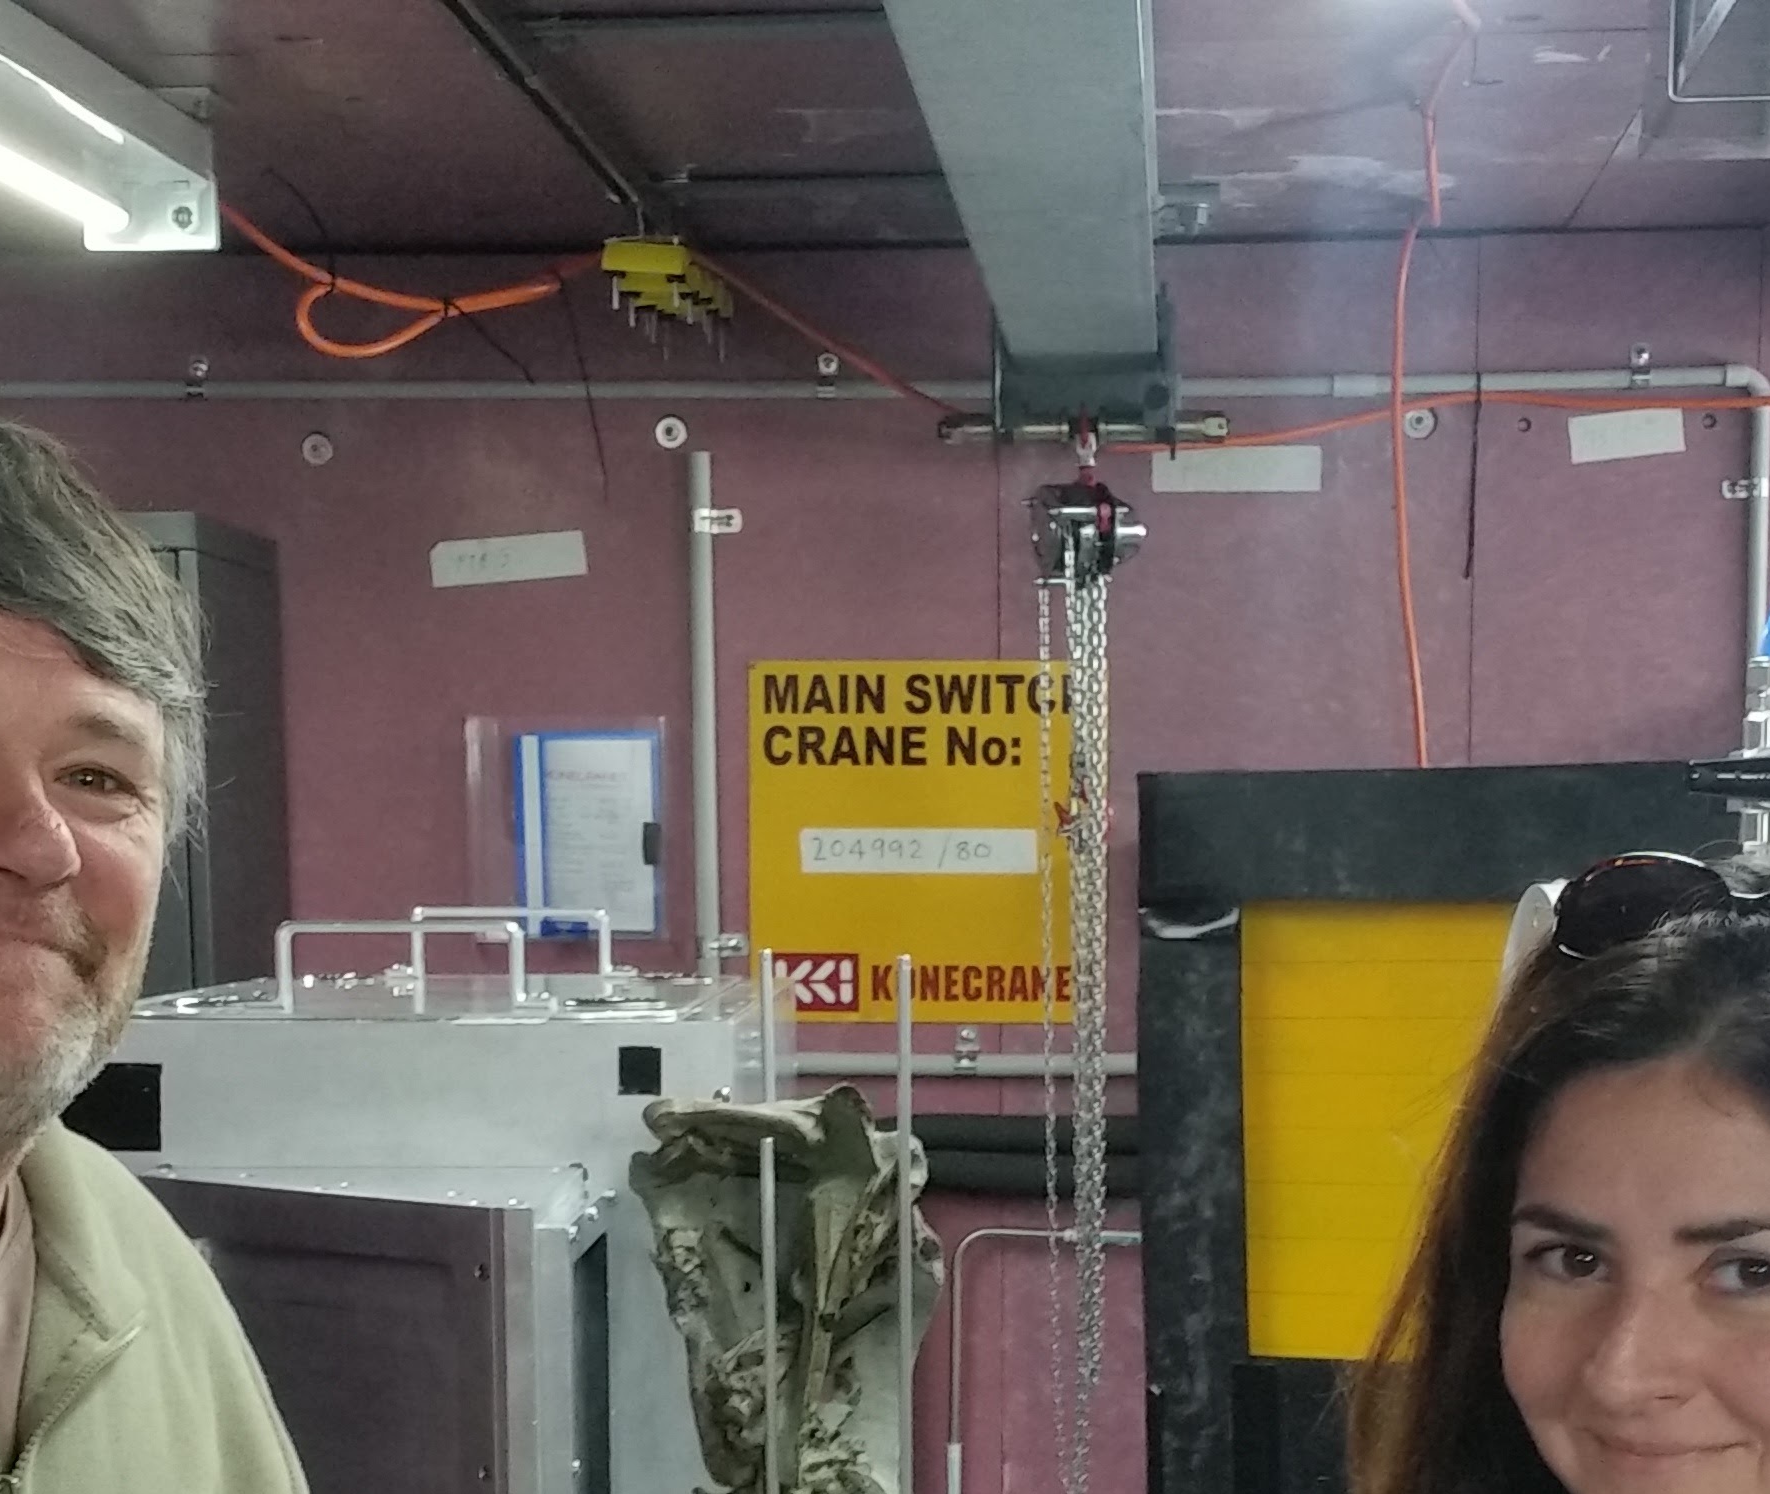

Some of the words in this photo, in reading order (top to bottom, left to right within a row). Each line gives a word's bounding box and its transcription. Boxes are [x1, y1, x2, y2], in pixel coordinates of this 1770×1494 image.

[762, 673, 886, 715] MAIN
[762, 725, 928, 767] CRANE
[946, 726, 1022, 767] No:
[812, 837, 923, 862] 204992
[871, 964, 1072, 1003] KNECRANE
